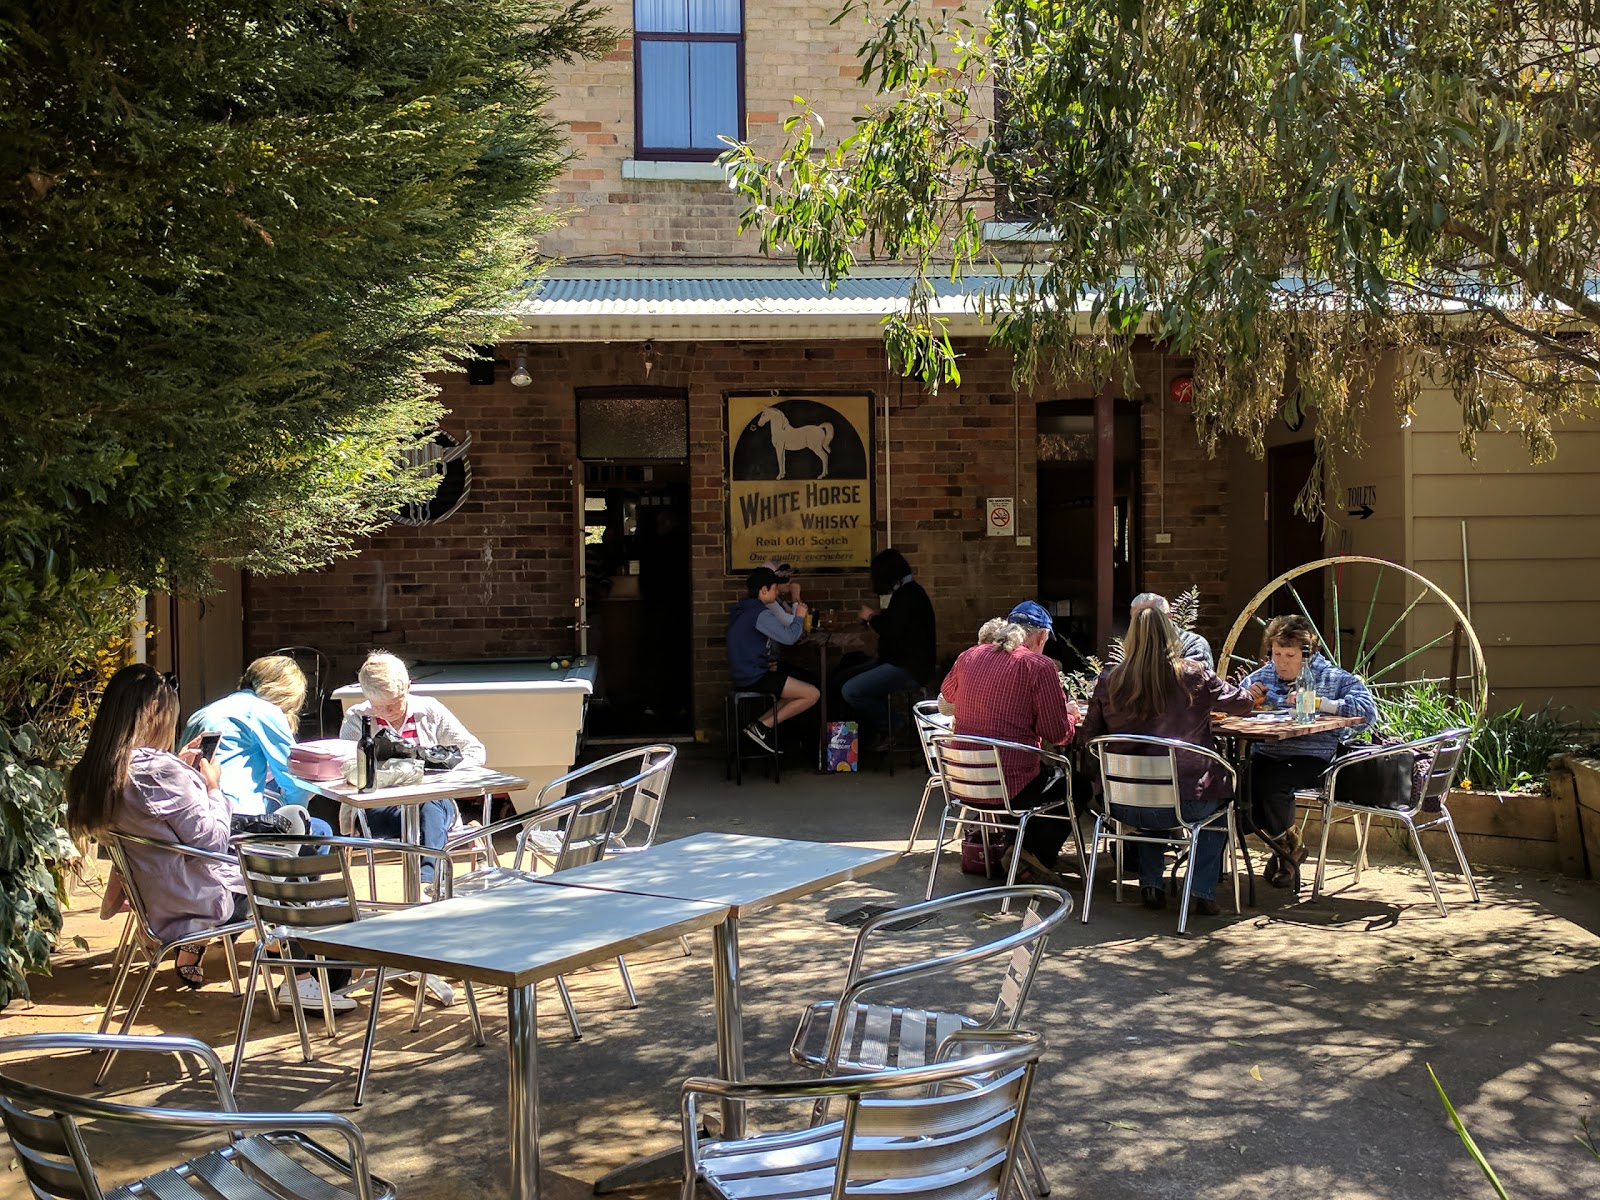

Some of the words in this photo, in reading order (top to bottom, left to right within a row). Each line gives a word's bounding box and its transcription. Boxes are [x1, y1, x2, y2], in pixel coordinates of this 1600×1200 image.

[1347, 485, 1376, 507] TOILETS
[739, 490, 800, 529] WHITE
[806, 482, 861, 508] HORSE
[800, 513, 859, 529] WHISKY
[756, 537, 780, 546] Real
[786, 536, 805, 546] Old
[811, 536, 849, 546] Scotch
[749, 553, 766, 561] One
[804, 552, 854, 561] everywhere
